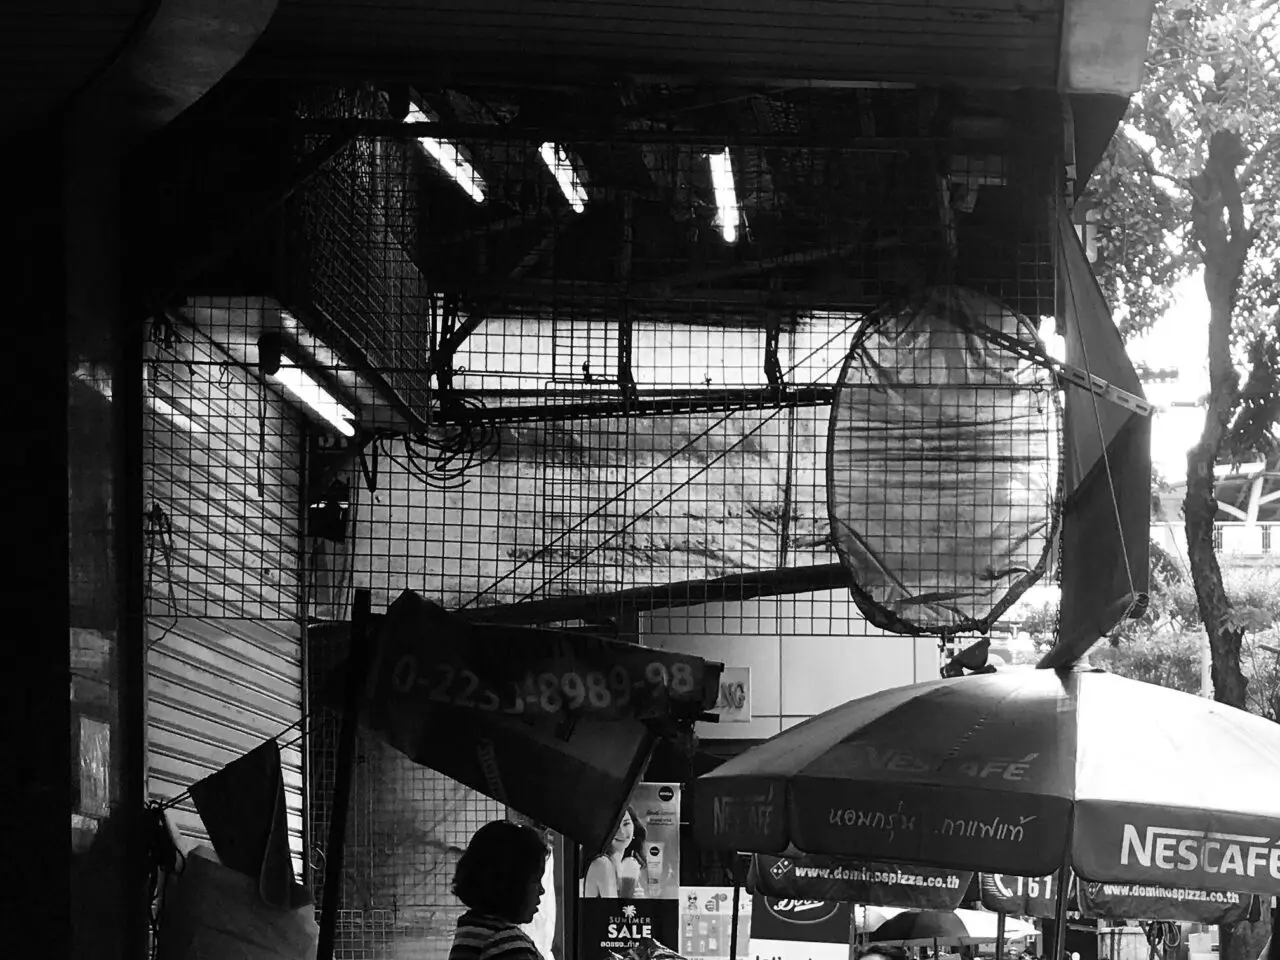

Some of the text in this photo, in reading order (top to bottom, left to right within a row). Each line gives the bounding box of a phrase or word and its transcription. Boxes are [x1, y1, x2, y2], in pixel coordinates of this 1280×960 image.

[716, 682, 746, 708] NG
[1103, 884, 1240, 904] www.dominospizza.co.th
[608, 924, 652, 939] SALE
